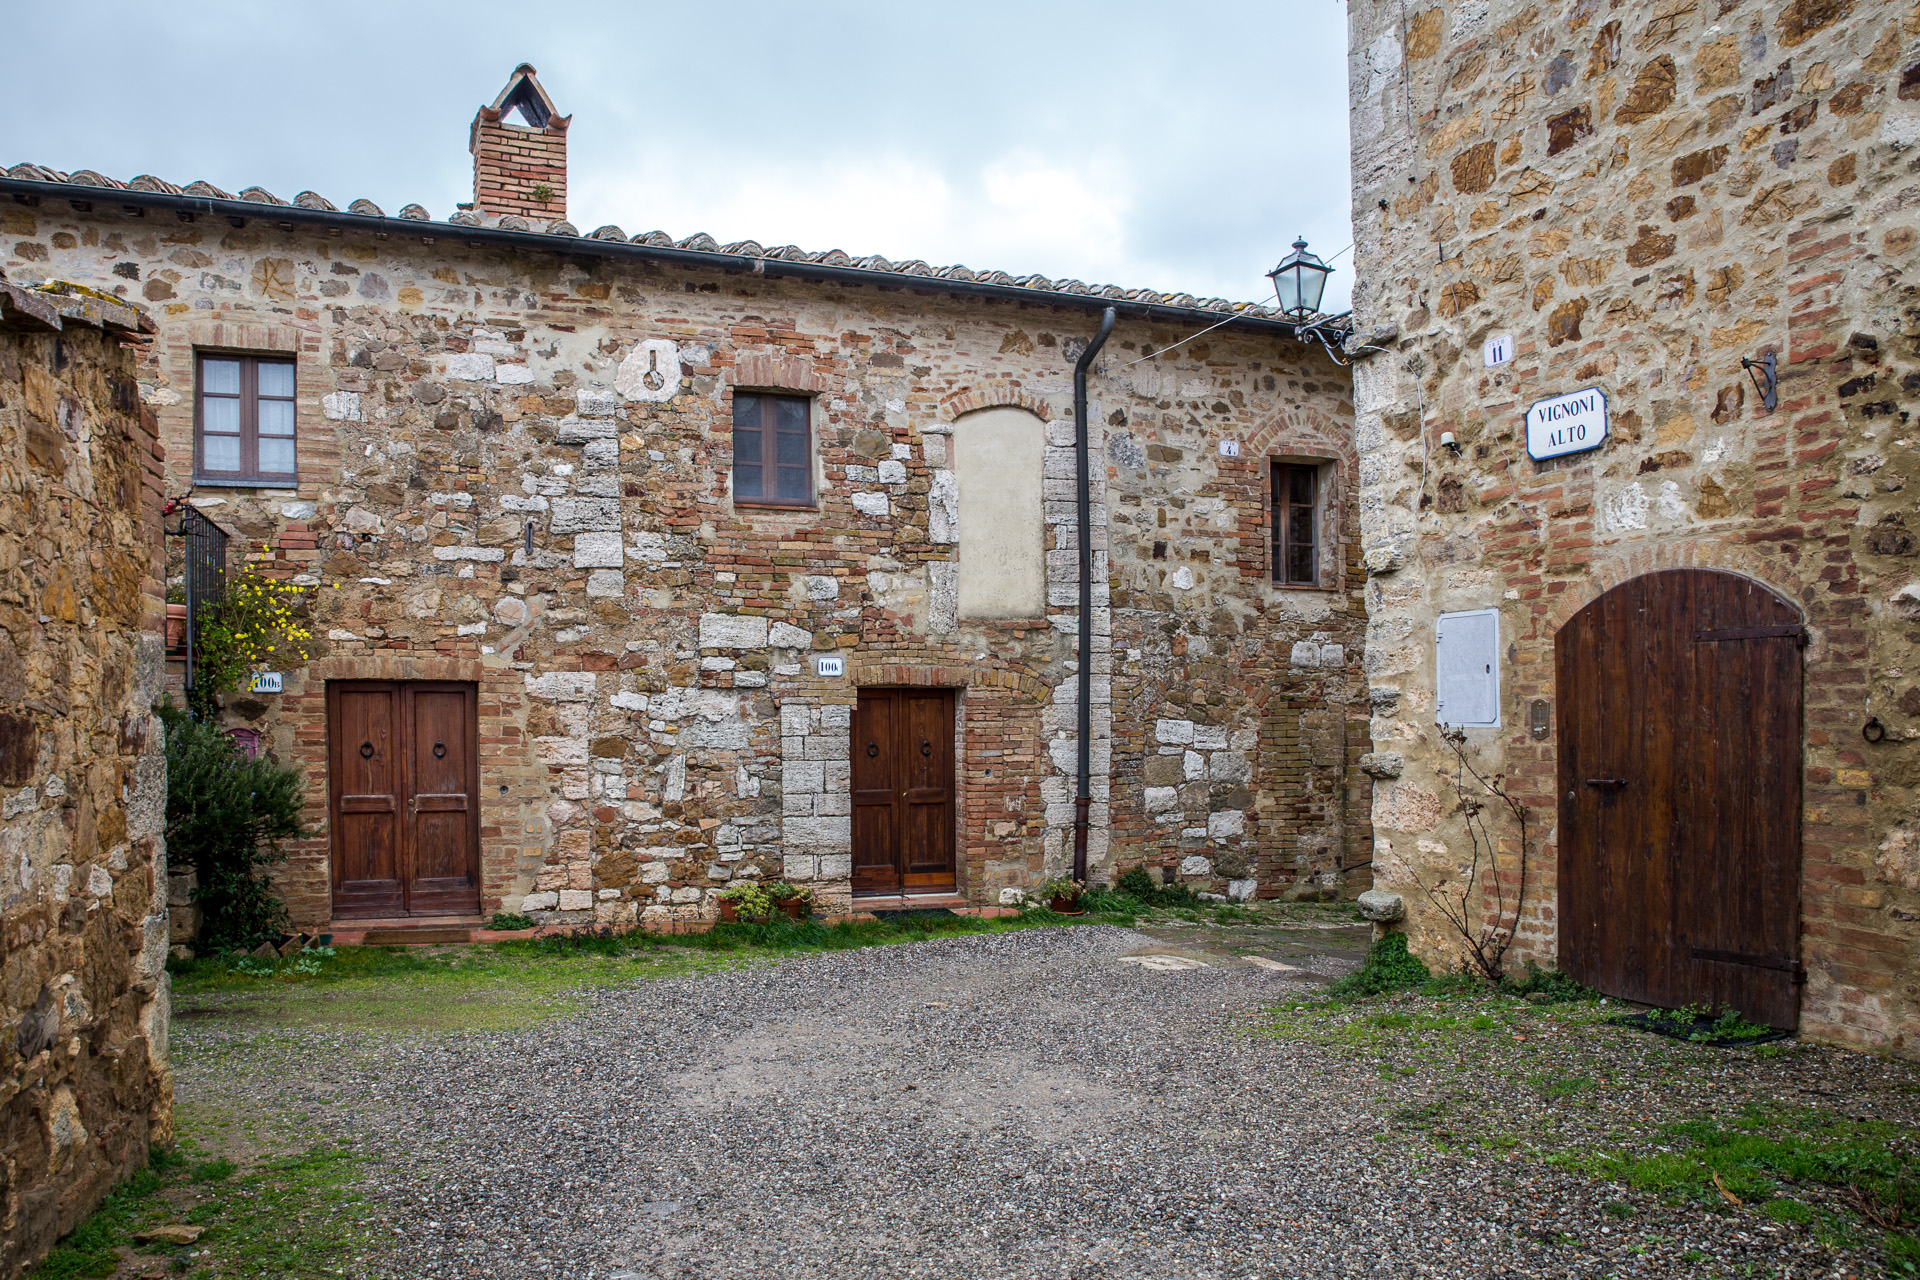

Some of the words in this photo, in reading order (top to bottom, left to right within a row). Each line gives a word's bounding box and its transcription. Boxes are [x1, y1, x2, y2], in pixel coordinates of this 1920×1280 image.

[1492, 345, 1503, 363] 11
[1538, 395, 1594, 423] VIGNONI
[1548, 424, 1586, 448] ALTO
